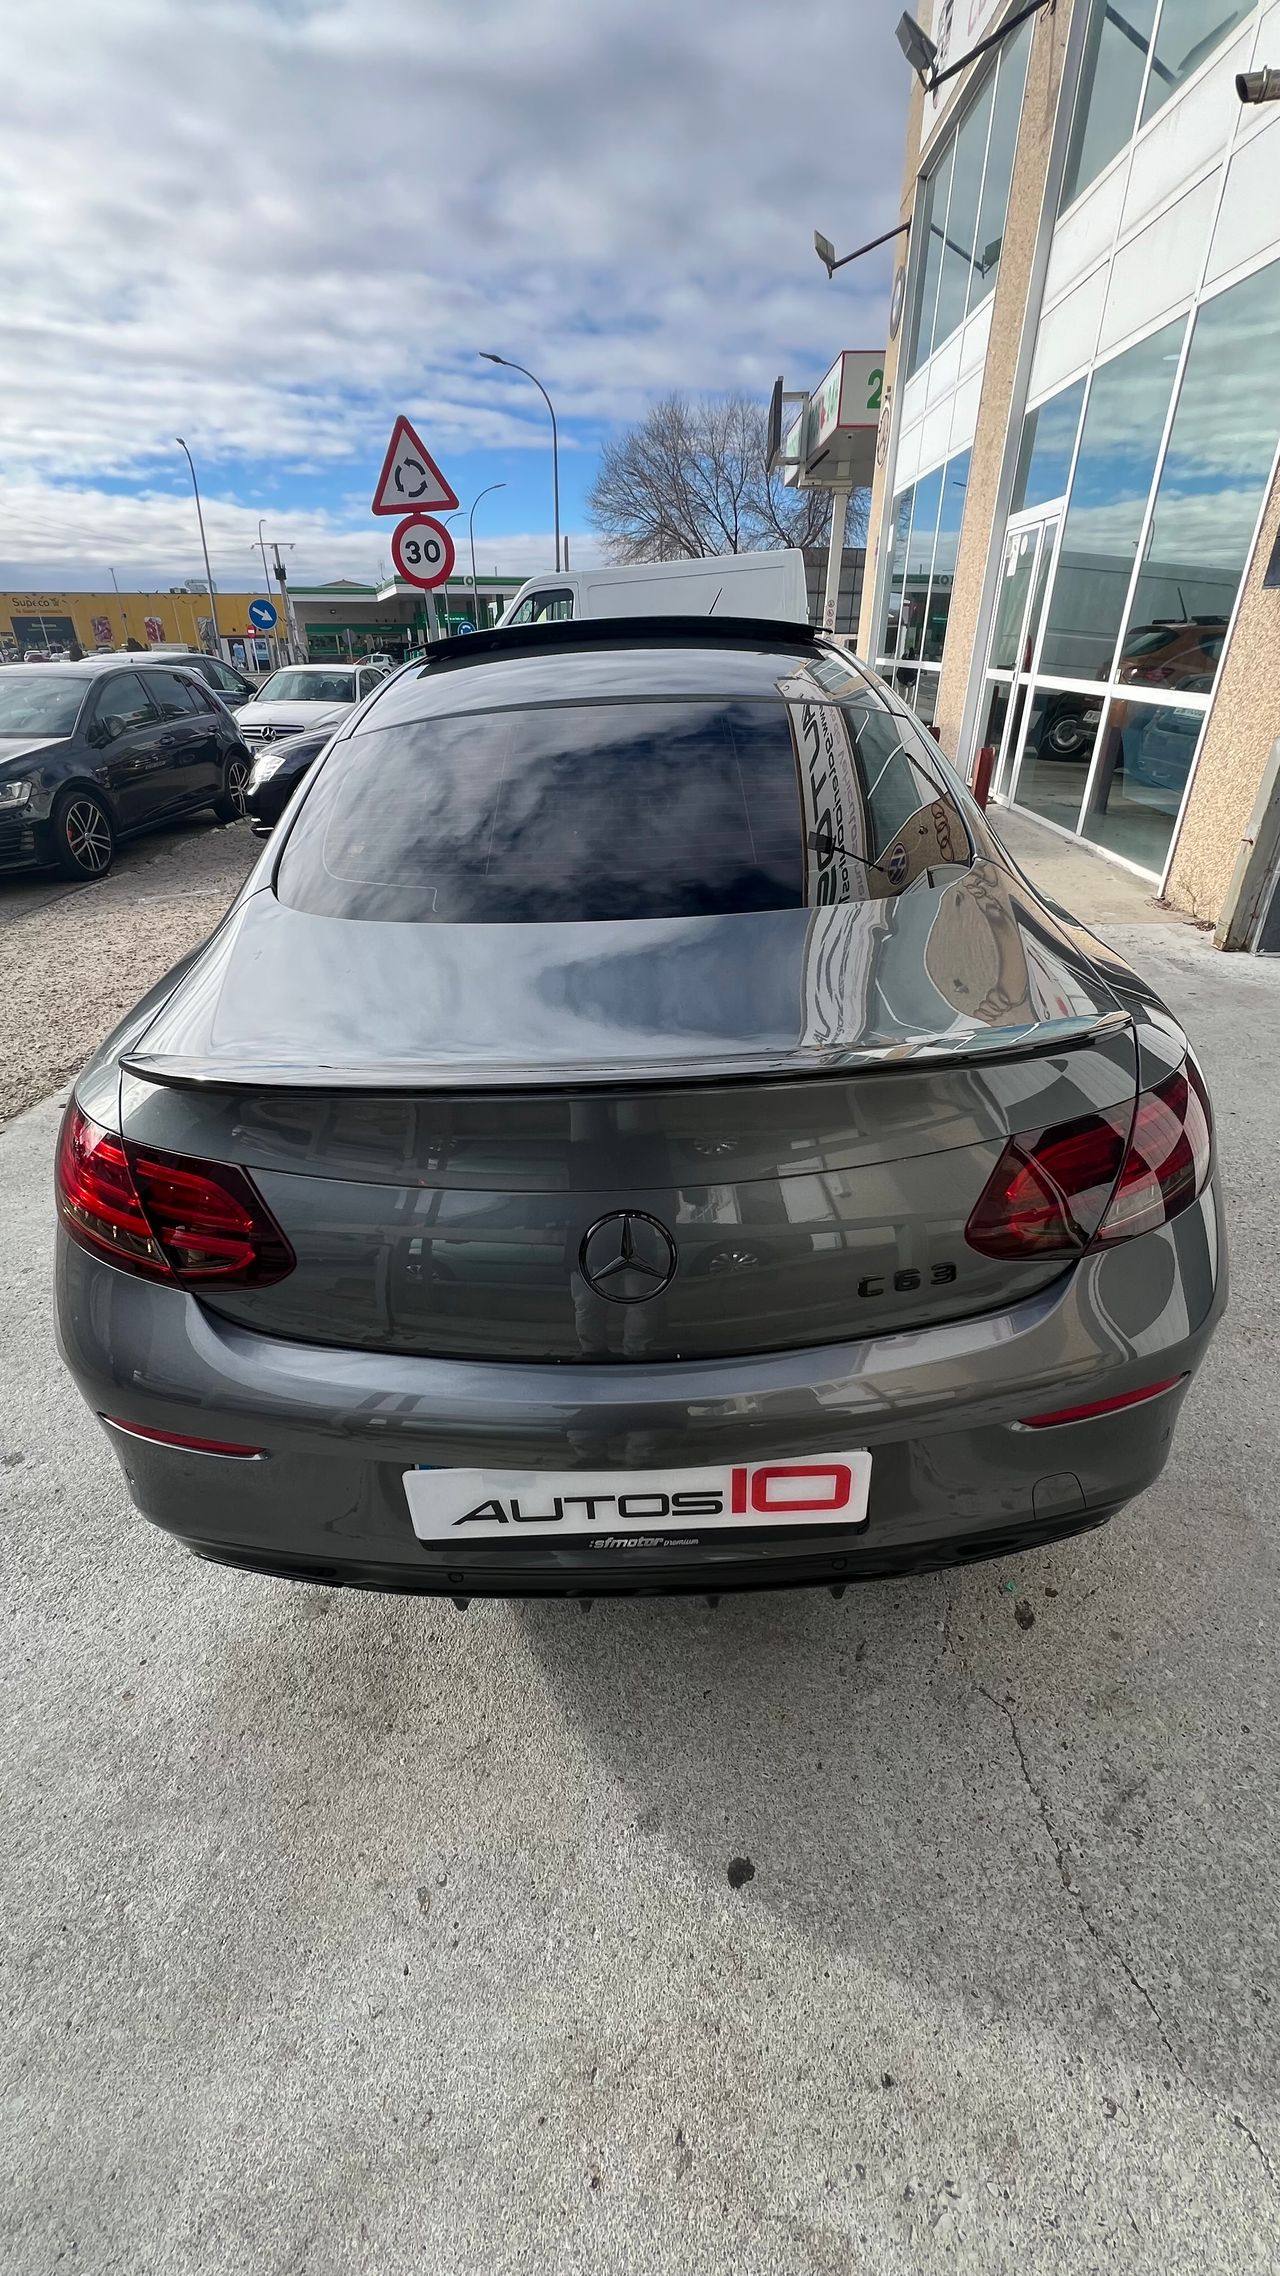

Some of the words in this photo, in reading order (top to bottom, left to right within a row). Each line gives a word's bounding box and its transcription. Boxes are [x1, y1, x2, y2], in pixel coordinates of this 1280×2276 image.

[405, 539, 441, 564] 30
[857, 1261, 958, 1298] C63
[663, 1538, 699, 1547] premium
